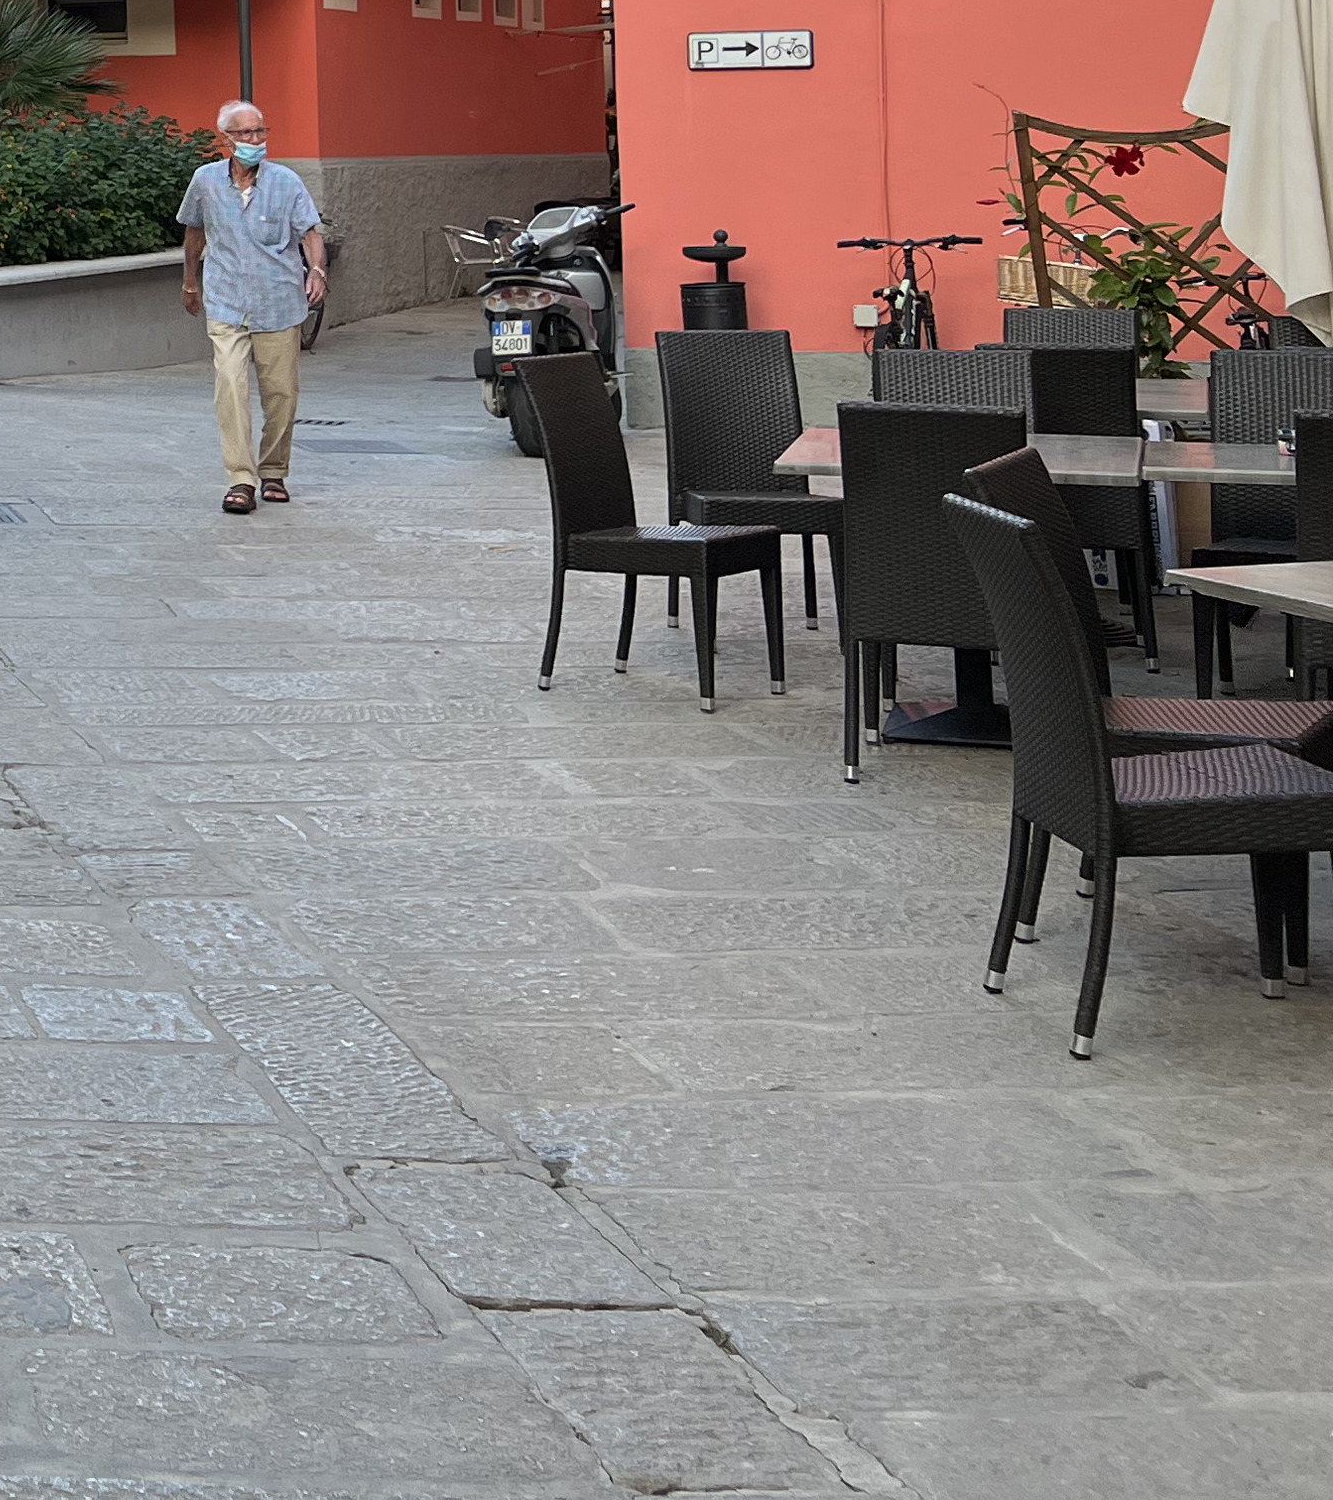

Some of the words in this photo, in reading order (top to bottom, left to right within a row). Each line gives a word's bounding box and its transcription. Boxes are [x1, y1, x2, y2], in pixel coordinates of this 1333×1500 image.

[697, 40, 714, 61] P
[501, 321, 516, 335] DV
[494, 338, 528, 352] 34801
